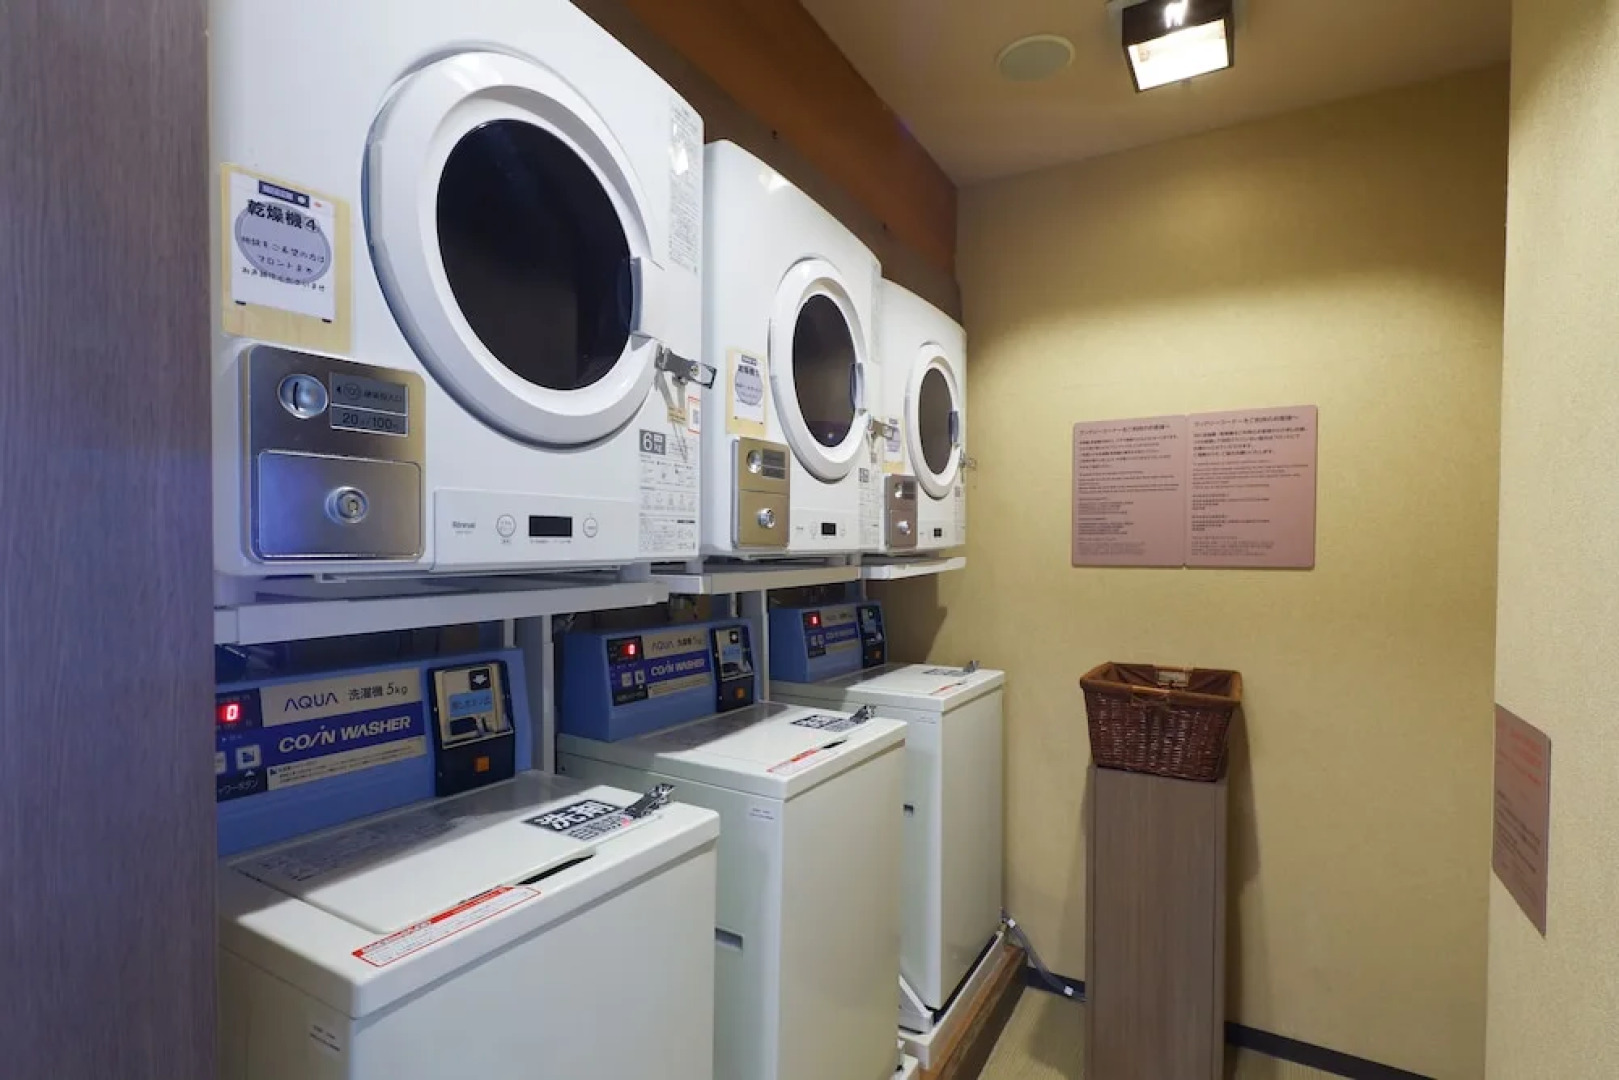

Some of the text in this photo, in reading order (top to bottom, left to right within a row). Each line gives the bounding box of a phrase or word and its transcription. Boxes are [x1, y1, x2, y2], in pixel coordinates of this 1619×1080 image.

[643, 432, 653, 451] 6
[284, 682, 409, 712] AQUA 洗濯機 5kg
[225, 704, 239, 722] 0
[279, 715, 412, 753] COIN WASHER
